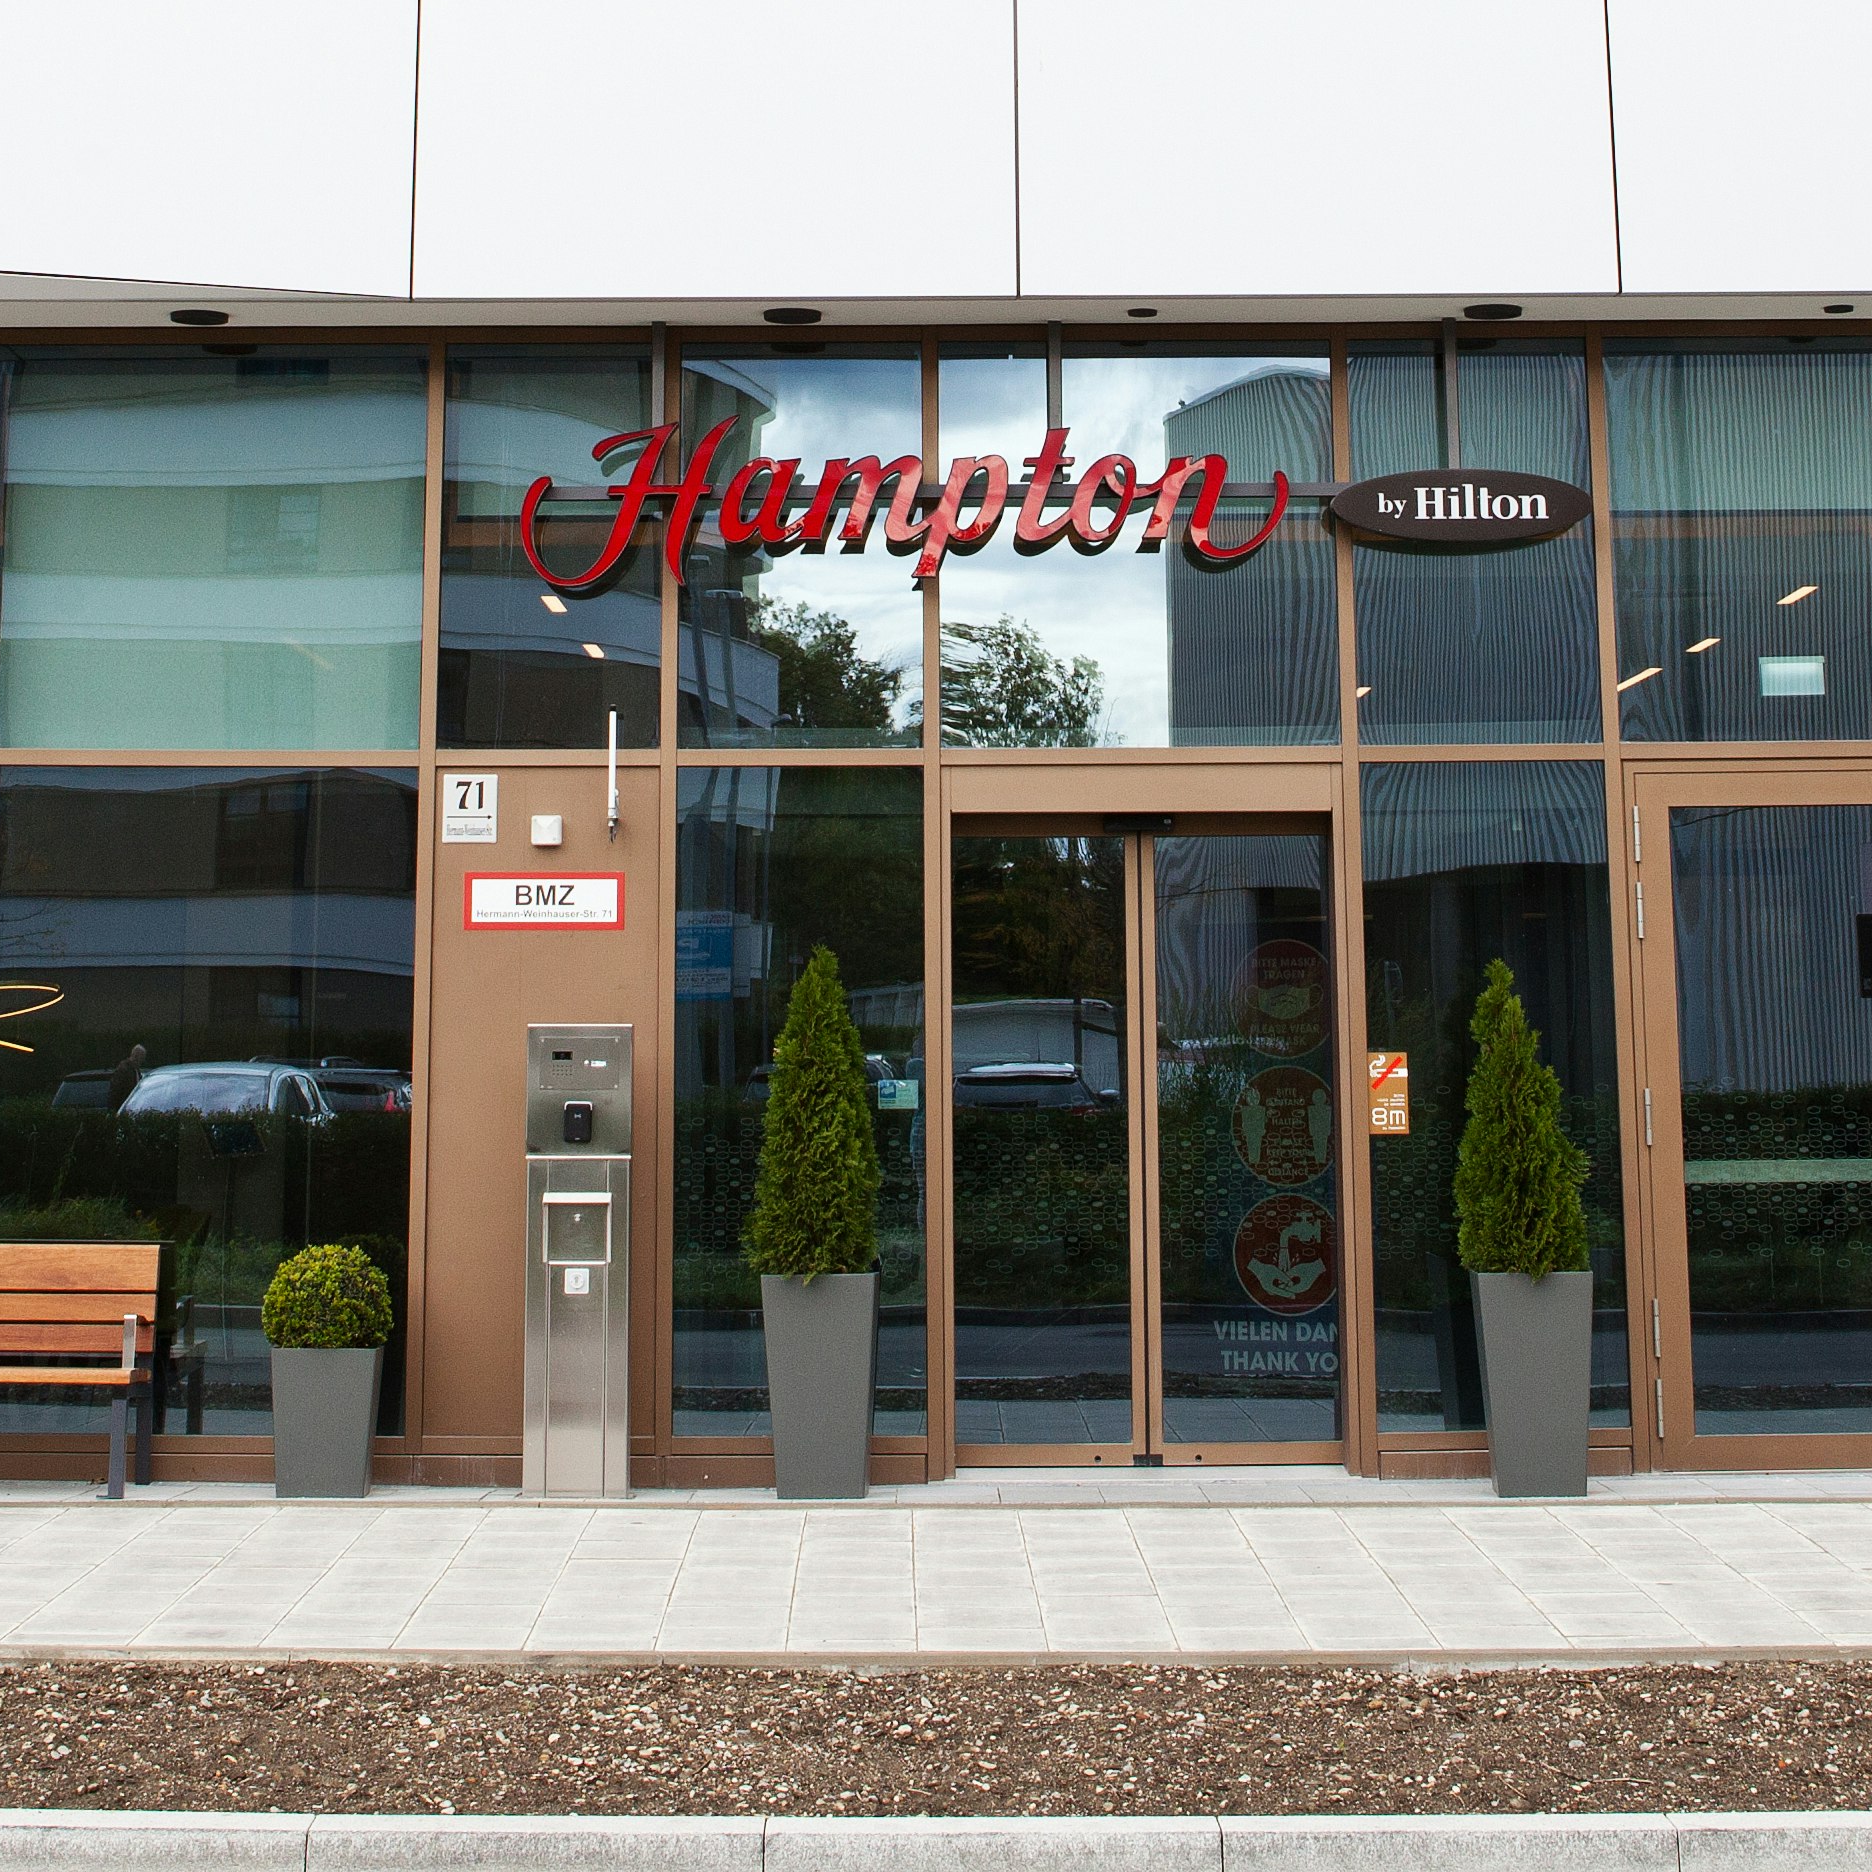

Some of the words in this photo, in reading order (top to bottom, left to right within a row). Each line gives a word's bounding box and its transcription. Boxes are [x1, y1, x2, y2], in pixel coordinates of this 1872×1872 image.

[524, 414, 1289, 587] Hampton
[1378, 493, 1408, 519] by
[1414, 484, 1549, 520] Hilton
[456, 781, 484, 809] 71
[515, 885, 575, 906] BMZ
[476, 909, 599, 918] Hermann-Weinhauser-Str.
[602, 909, 613, 918] 71
[1214, 1320, 1288, 1341] VIELEN
[1295, 1321, 1339, 1342] DAN
[1221, 1350, 1300, 1371] THANK
[1305, 1351, 1339, 1372] YO
